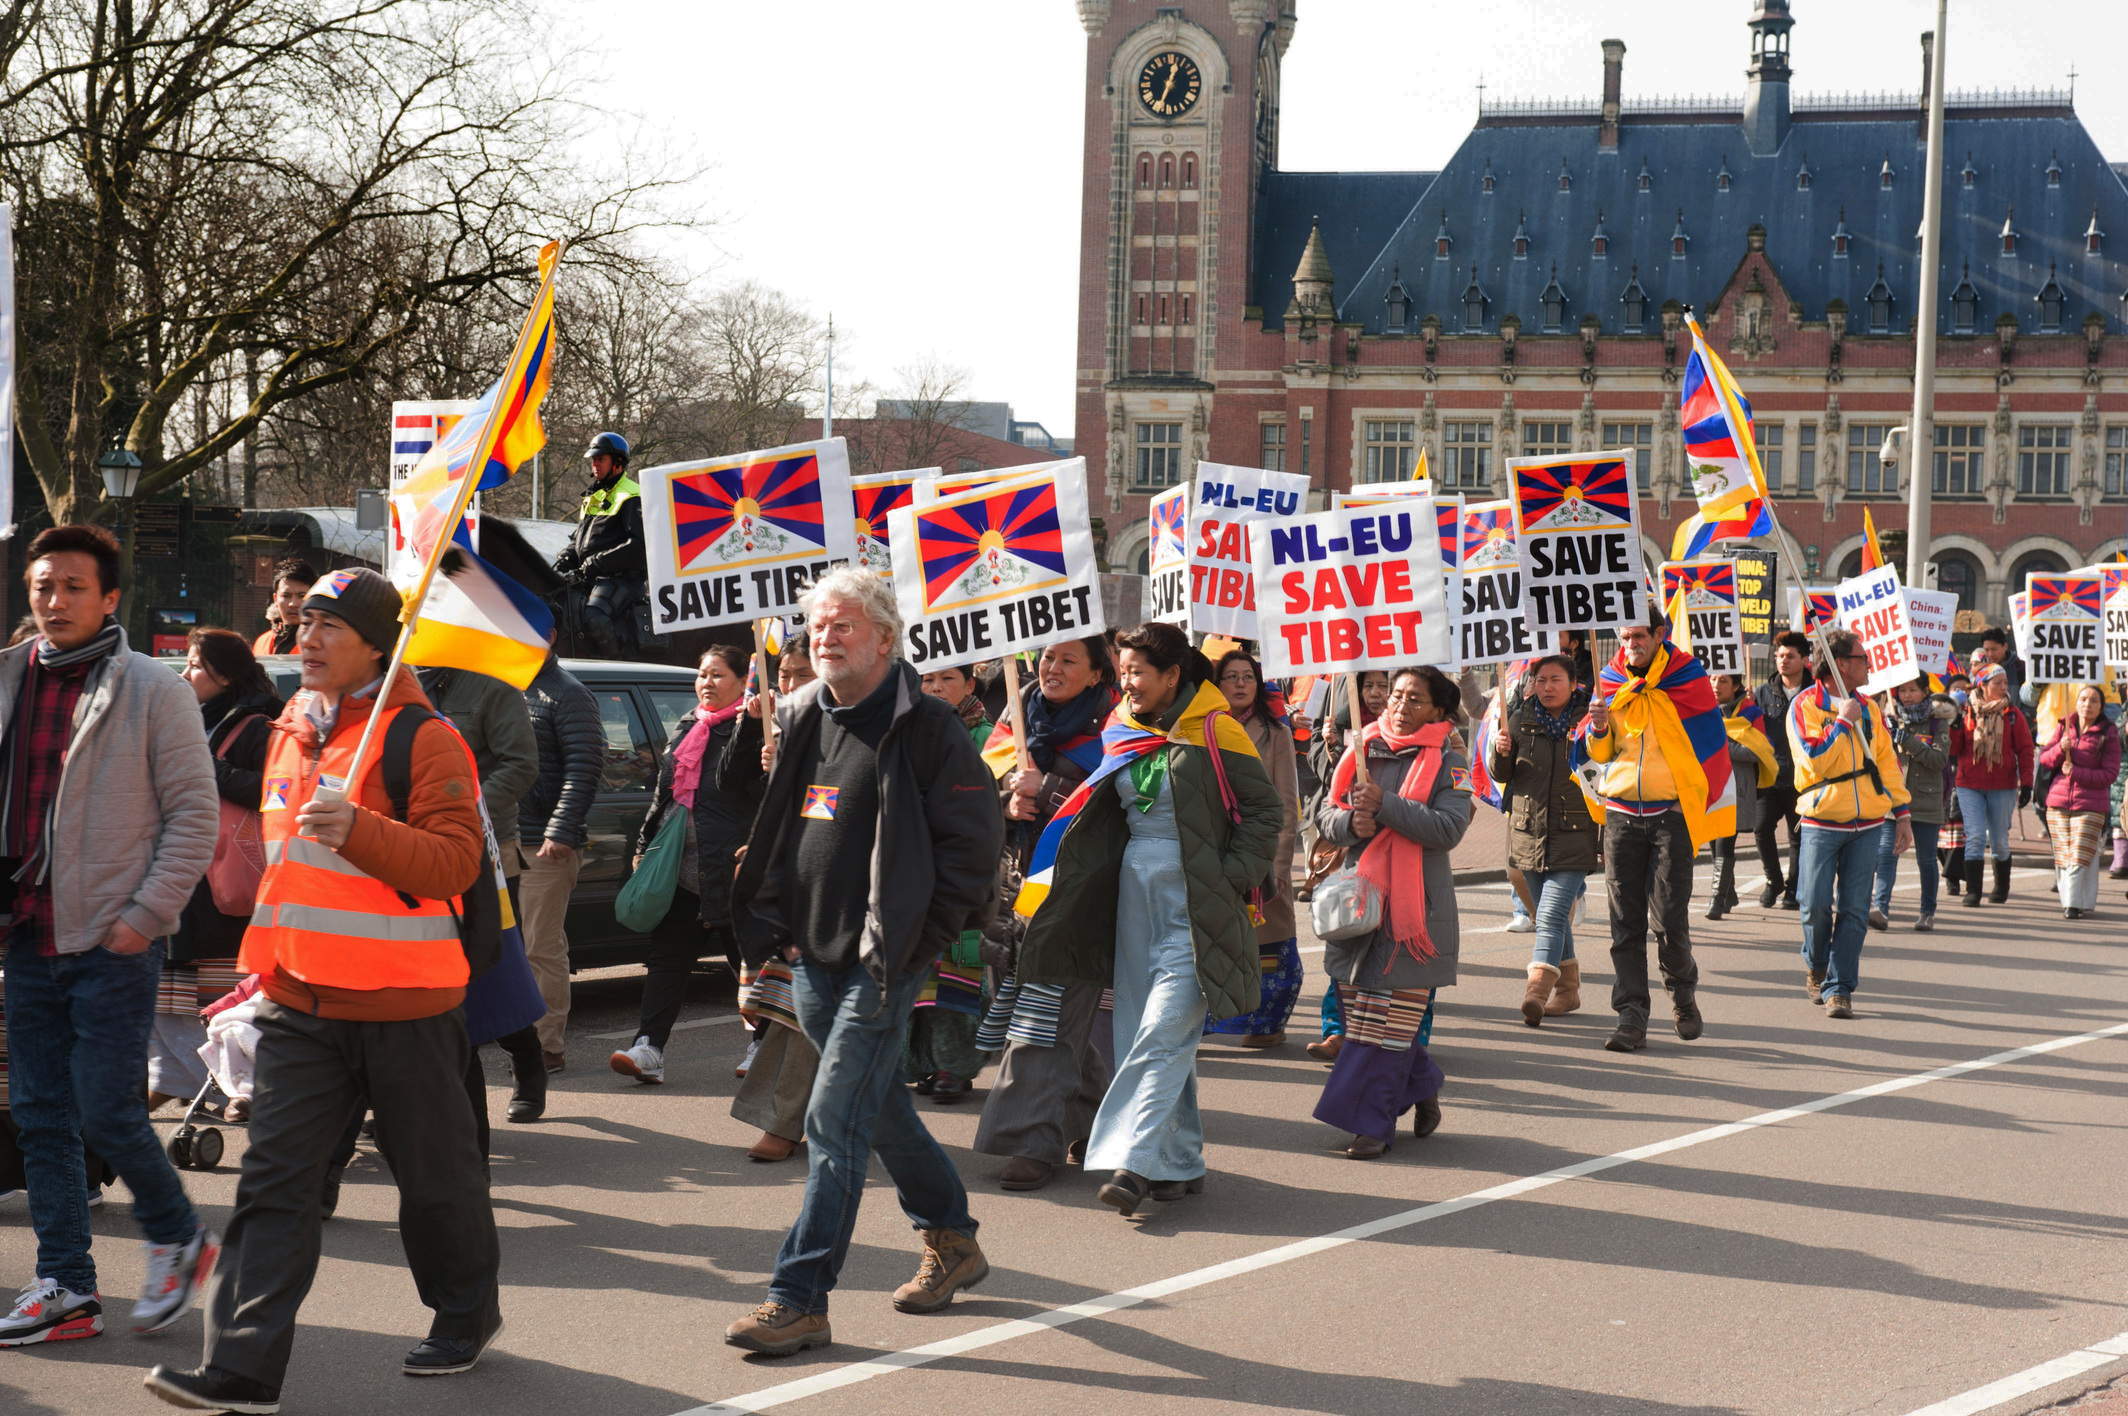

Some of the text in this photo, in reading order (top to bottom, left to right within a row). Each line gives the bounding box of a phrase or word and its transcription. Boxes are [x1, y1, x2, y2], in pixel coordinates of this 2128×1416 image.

[394, 463, 408, 480] THE
[1200, 481, 1299, 516] NL-EU
[1196, 519, 1252, 564] SA
[1270, 512, 1413, 566] NL-EU
[1528, 533, 1630, 578] SAVE
[1737, 559, 1768, 577] HINA:
[658, 573, 745, 624] SAVE
[1190, 564, 1256, 612] TIB
[1281, 559, 1414, 615] SAVE
[1462, 571, 1520, 616] SAV
[1529, 580, 1638, 625] TIBET
[1738, 578, 1762, 595] TOP
[1841, 577, 1896, 612] NL-EU
[1739, 597, 1772, 615] WELD
[1910, 600, 1944, 615] China:
[908, 585, 1092, 664] SAVE TIBET
[1280, 610, 1422, 666] TIBET
[1688, 612, 1734, 639] AVE
[1850, 603, 1903, 645] SAVE
[1910, 617, 1948, 632] here is
[1913, 635, 1945, 648] nchen
[2033, 624, 2096, 650] SAVE
[1692, 643, 1738, 670] BET
[1865, 634, 1910, 674] IBET
[2030, 654, 2100, 680] TIBET
